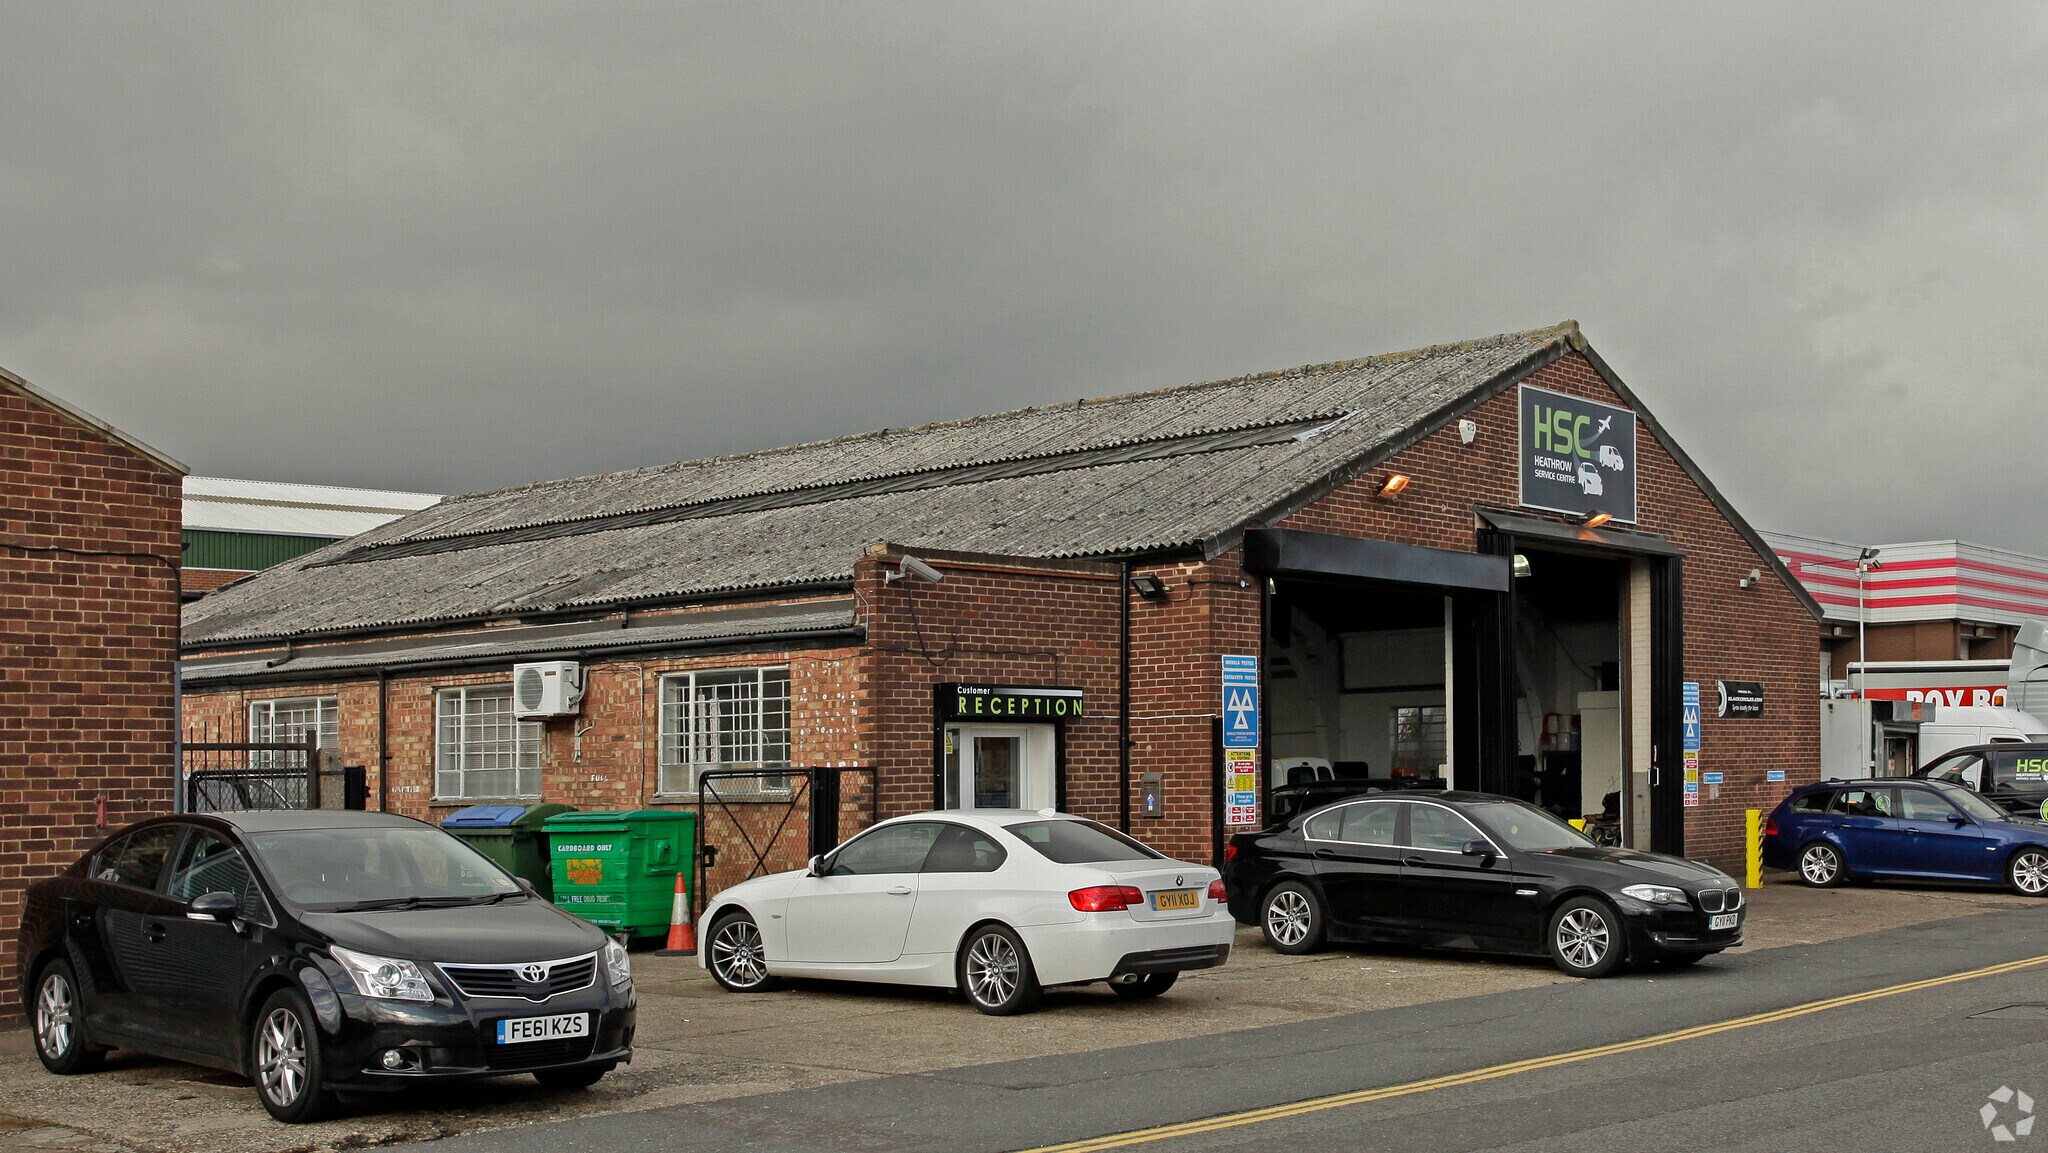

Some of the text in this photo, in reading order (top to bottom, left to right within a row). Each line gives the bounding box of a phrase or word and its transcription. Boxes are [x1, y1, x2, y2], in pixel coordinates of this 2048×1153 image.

[1534, 404, 1591, 459] HSC
[1534, 455, 1573, 472] HEATHROW
[1534, 469, 1575, 484] SERVICE CENTRE
[957, 685, 991, 695] Customer
[958, 696, 1083, 716] RECEPTION
[590, 774, 608, 782] FULL
[571, 895, 583, 903] FREE
[552, 1016, 582, 1035] KZS
